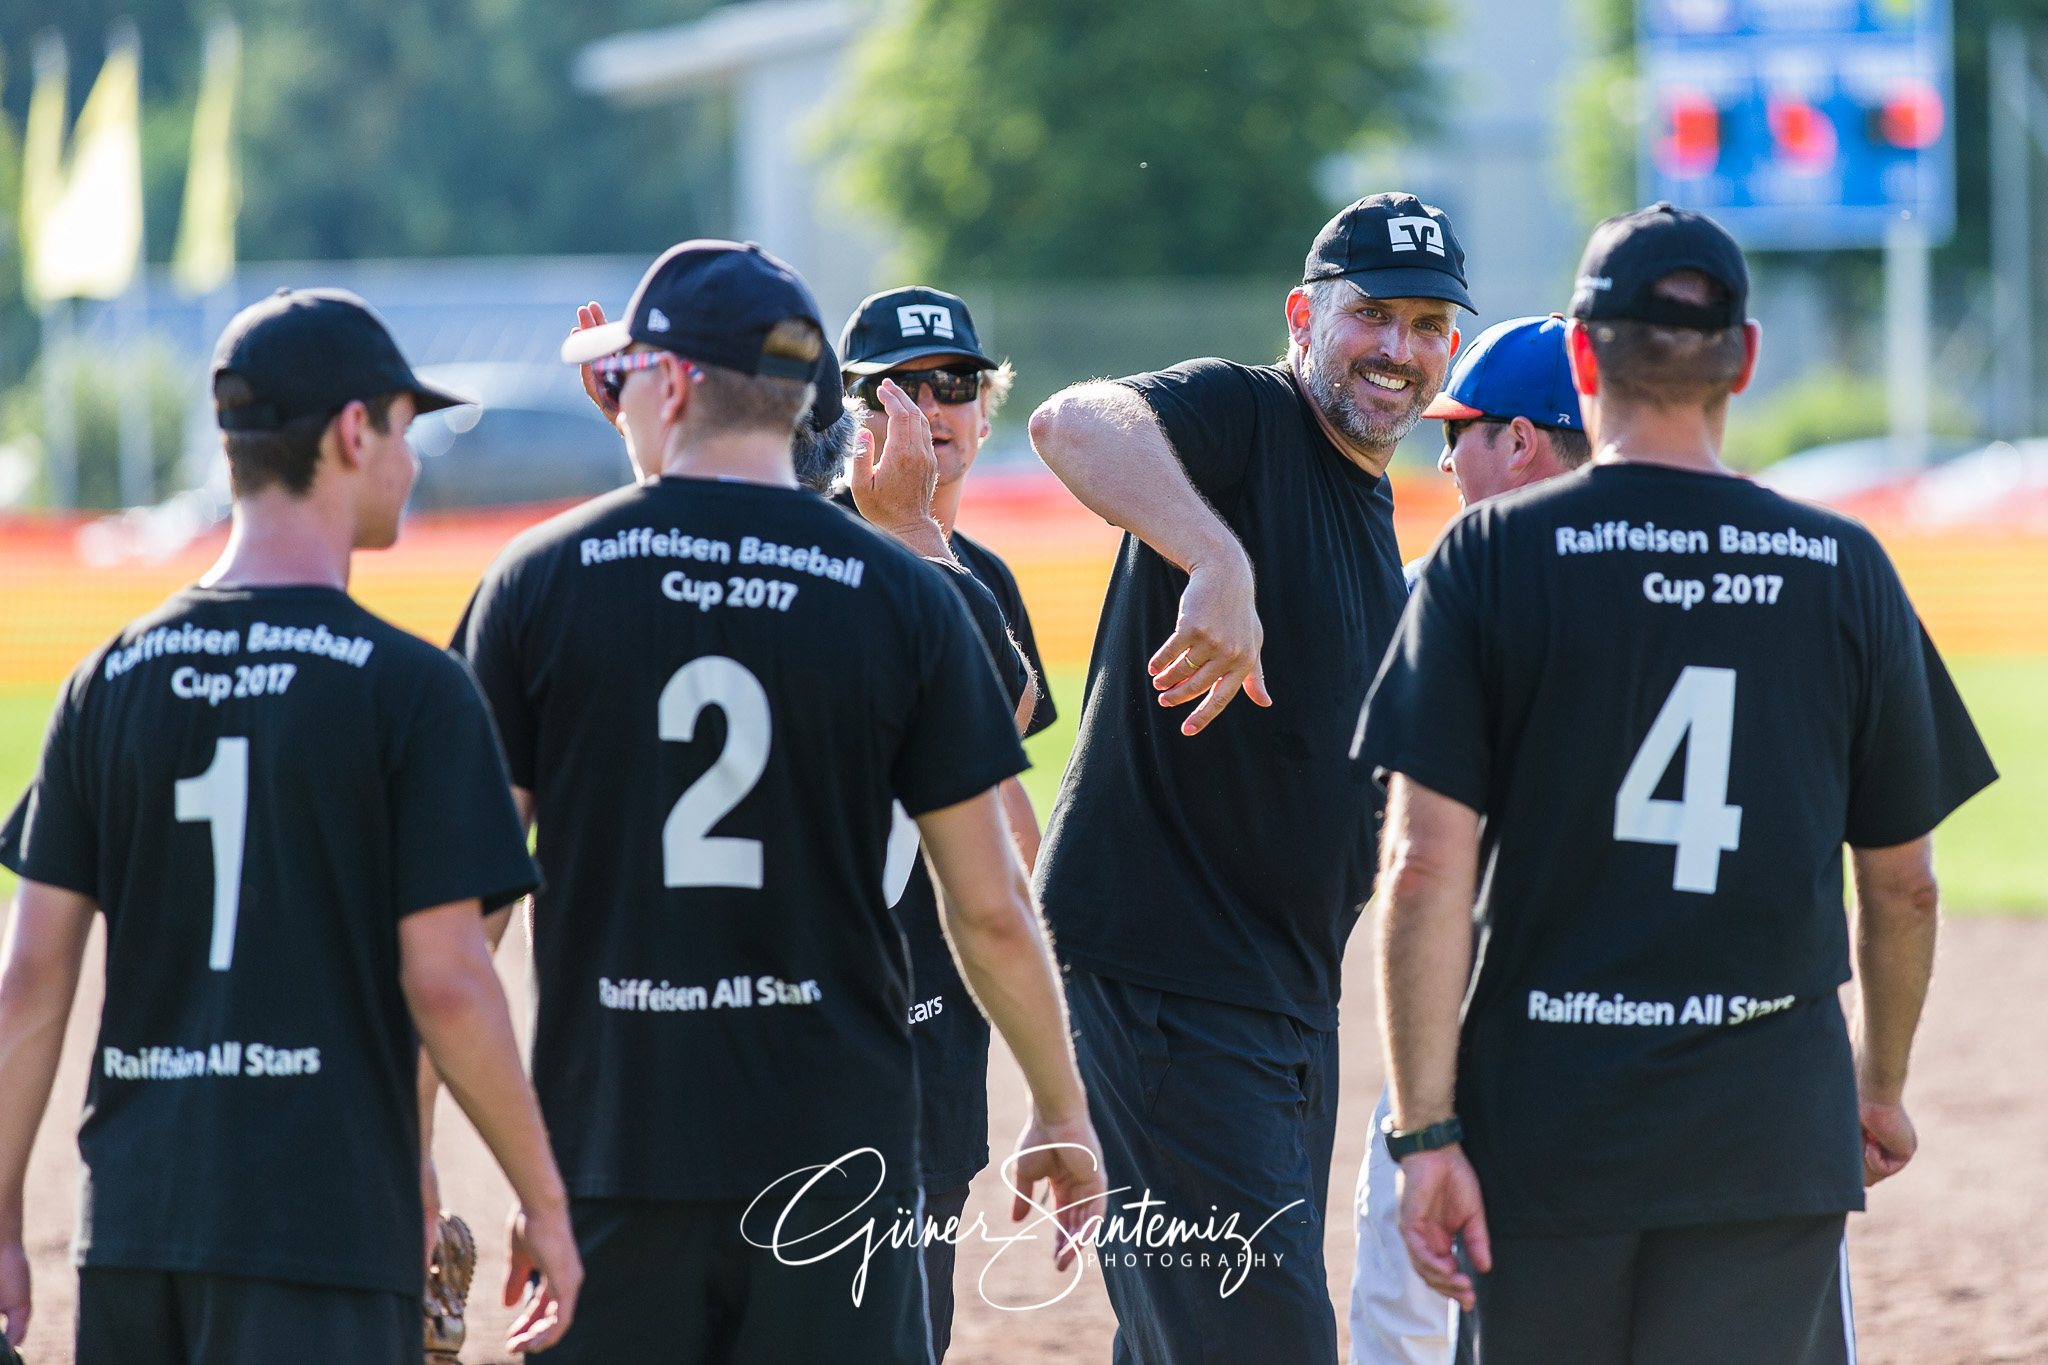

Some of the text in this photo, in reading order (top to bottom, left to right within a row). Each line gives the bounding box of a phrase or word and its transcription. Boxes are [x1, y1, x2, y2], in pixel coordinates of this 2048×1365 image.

[580, 527, 864, 588] Raiffeisen Baseball
[1555, 520, 1838, 567] Raiffeisen Baseball
[661, 571, 798, 612] Cup 2017
[1643, 572, 1783, 611] Cup 2017
[105, 622, 373, 681] Raiffeisen Baseball
[171, 663, 296, 706] Cup 2017
[658, 655, 772, 889] 2
[1613, 665, 1743, 894] 4
[174, 736, 249, 972] 1
[711, 976, 753, 1009] All
[756, 976, 823, 1006] Stars
[907, 995, 943, 1025] tars
[1528, 990, 1675, 1026] Raiffeisen
[1679, 994, 1724, 1026] All
[206, 1041, 243, 1077] All
[245, 1042, 322, 1077] Stars
